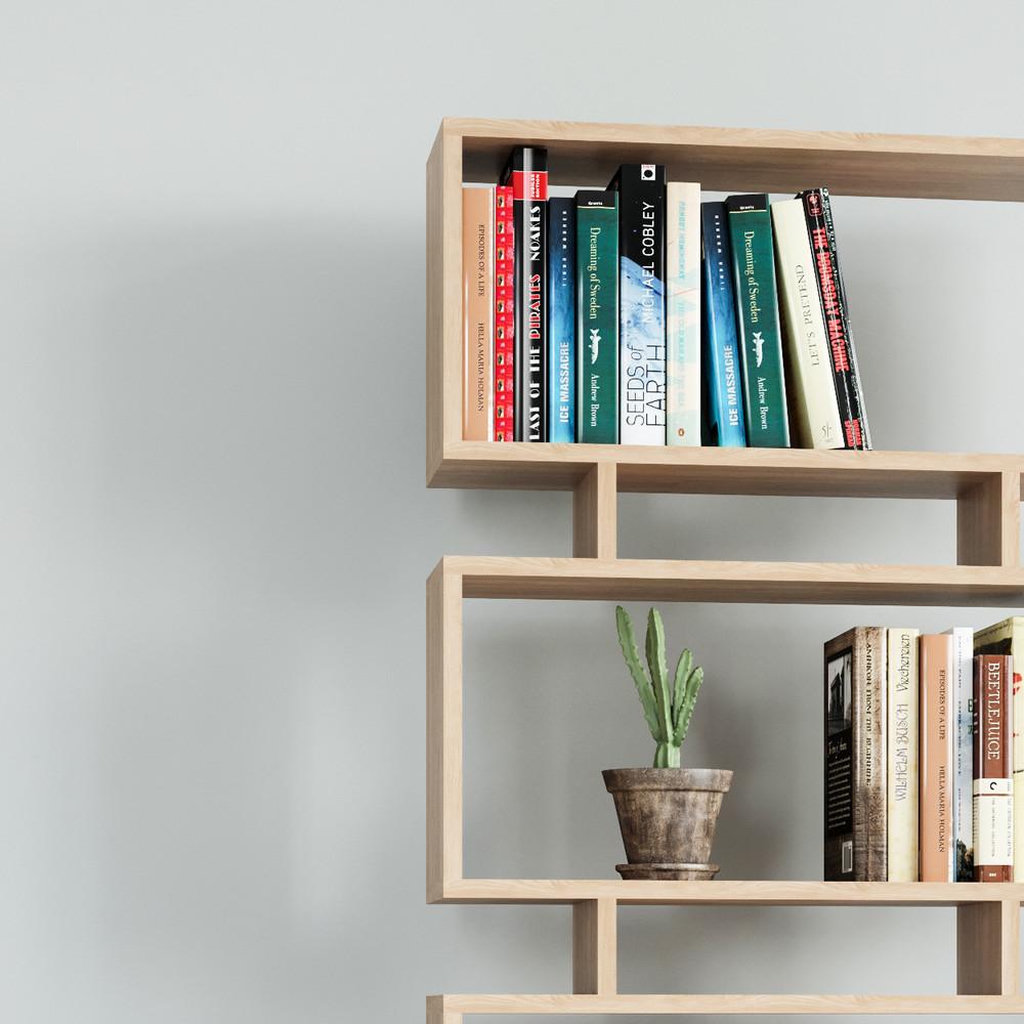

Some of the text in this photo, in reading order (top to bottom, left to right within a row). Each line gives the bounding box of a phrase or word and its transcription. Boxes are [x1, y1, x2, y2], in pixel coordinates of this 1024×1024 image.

[478, 224, 486, 260] EPISODES
[478, 261, 486, 271] OF
[529, 206, 541, 260] NOAKES
[587, 227, 601, 319] Dreaming of Sweden
[642, 201, 655, 324] MICHAEL COBLEY
[812, 227, 828, 249] THE
[478, 280, 486, 297] LIFE
[744, 231, 761, 323] Dreaming of Sweden
[796, 264, 819, 366] LET'S PRETEND
[816, 252, 839, 315] DOOMSDAY
[529, 274, 541, 440] LAST OF THE PIRATES
[560, 341, 569, 423] ICE MASSACRE
[626, 344, 644, 426] SEEDS of
[646, 345, 667, 426] EARTH
[724, 345, 738, 426] ICE MASSACRE
[828, 319, 850, 372] MACHINE
[590, 373, 600, 427] Andrew Brown
[758, 377, 769, 430] Andrew Brown
[939, 706, 946, 716] OF
[988, 662, 1000, 760] BEETLEJUICE
[896, 704, 908, 801] WILHELM BUSCH
